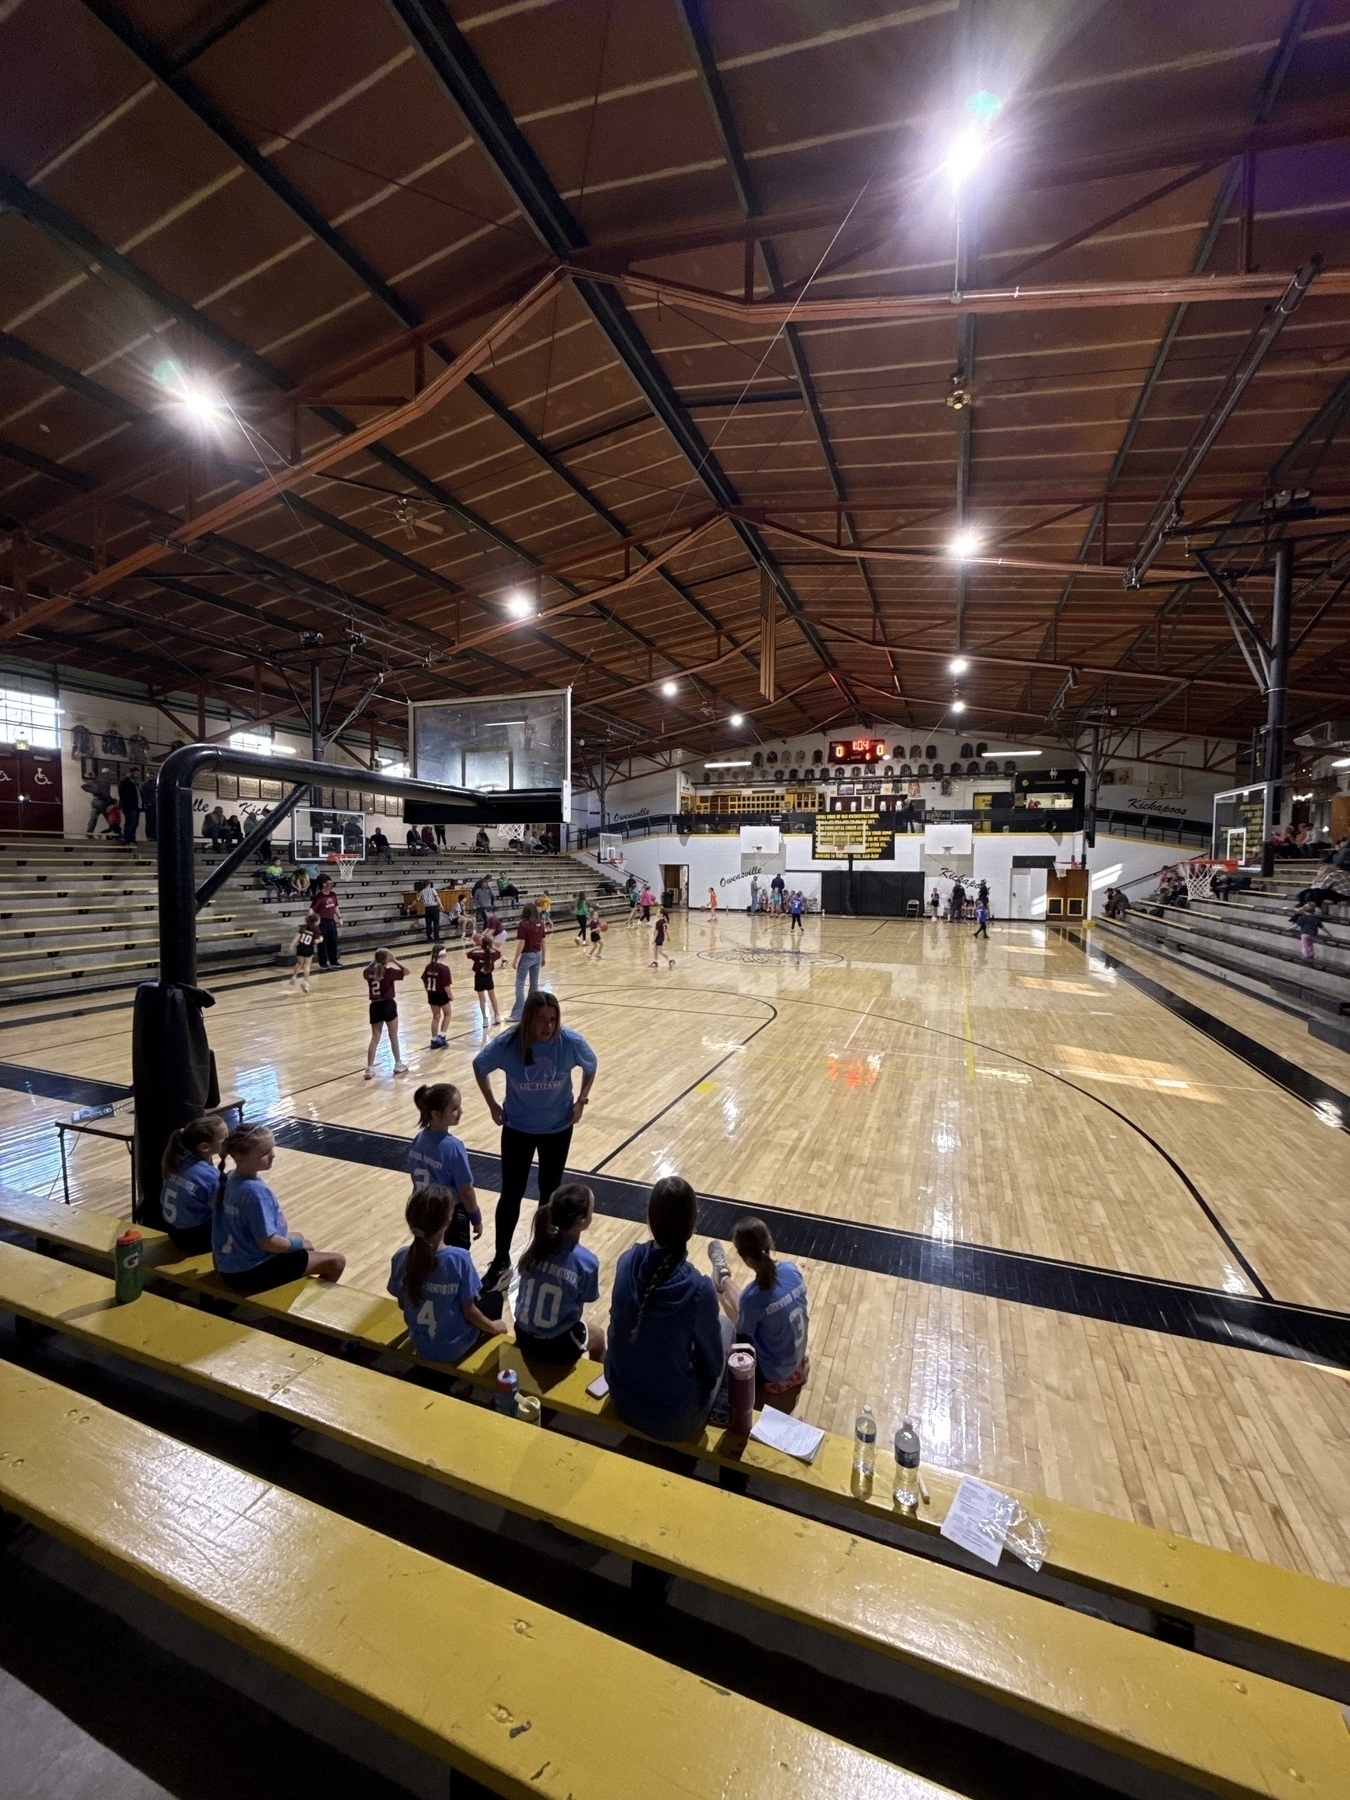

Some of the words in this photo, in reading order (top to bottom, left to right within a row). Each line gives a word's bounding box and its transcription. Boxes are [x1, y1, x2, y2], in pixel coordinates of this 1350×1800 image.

[835, 745, 844, 757] 0
[852, 740, 869, 750] 1:04
[876, 744, 884, 756] 0
[614, 807, 650, 822] Owensville
[1127, 798, 1187, 815] Kickapoos
[720, 865, 762, 887] Owensville
[300, 933, 313, 945] 10
[371, 980, 381, 996] 2
[427, 977, 436, 991] 11
[414, 1167, 430, 1192] 2
[163, 1188, 178, 1223] 5
[123, 1252, 139, 1269] G
[519, 1278, 563, 1328] 10
[417, 1299, 437, 1339] 4
[788, 1306, 805, 1348] 3
